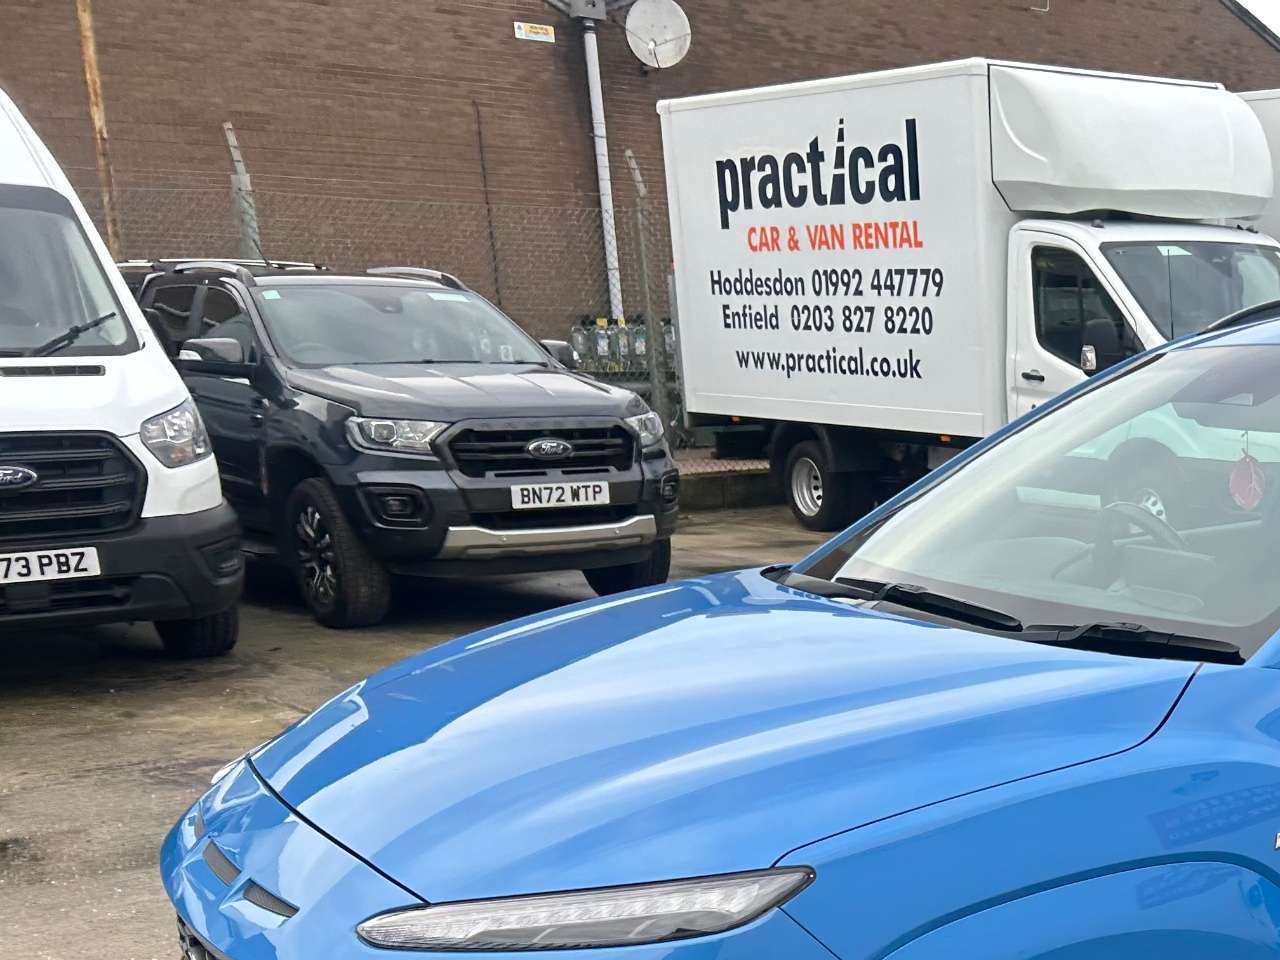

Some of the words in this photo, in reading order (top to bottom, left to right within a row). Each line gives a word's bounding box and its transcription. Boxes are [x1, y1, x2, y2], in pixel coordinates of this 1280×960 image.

[715, 118, 921, 229] practical
[747, 226, 781, 252] CAR
[787, 226, 800, 251] &
[806, 224, 845, 250] VAN
[852, 221, 923, 249] RENTAL
[710, 268, 805, 296] Hoddesdon
[812, 268, 863, 296] 01992
[870, 268, 944, 297] 447779
[722, 304, 780, 330] Enfield
[790, 304, 835, 332] 0203
[842, 305, 875, 333] 827
[884, 306, 933, 335] 8220
[735, 346, 922, 379] www.practical.co.uk
[541, 442, 563, 455] Ford
[520, 487, 565, 504] BN72
[570, 485, 602, 502] WTP
[37, 552, 88, 575] PBZ
